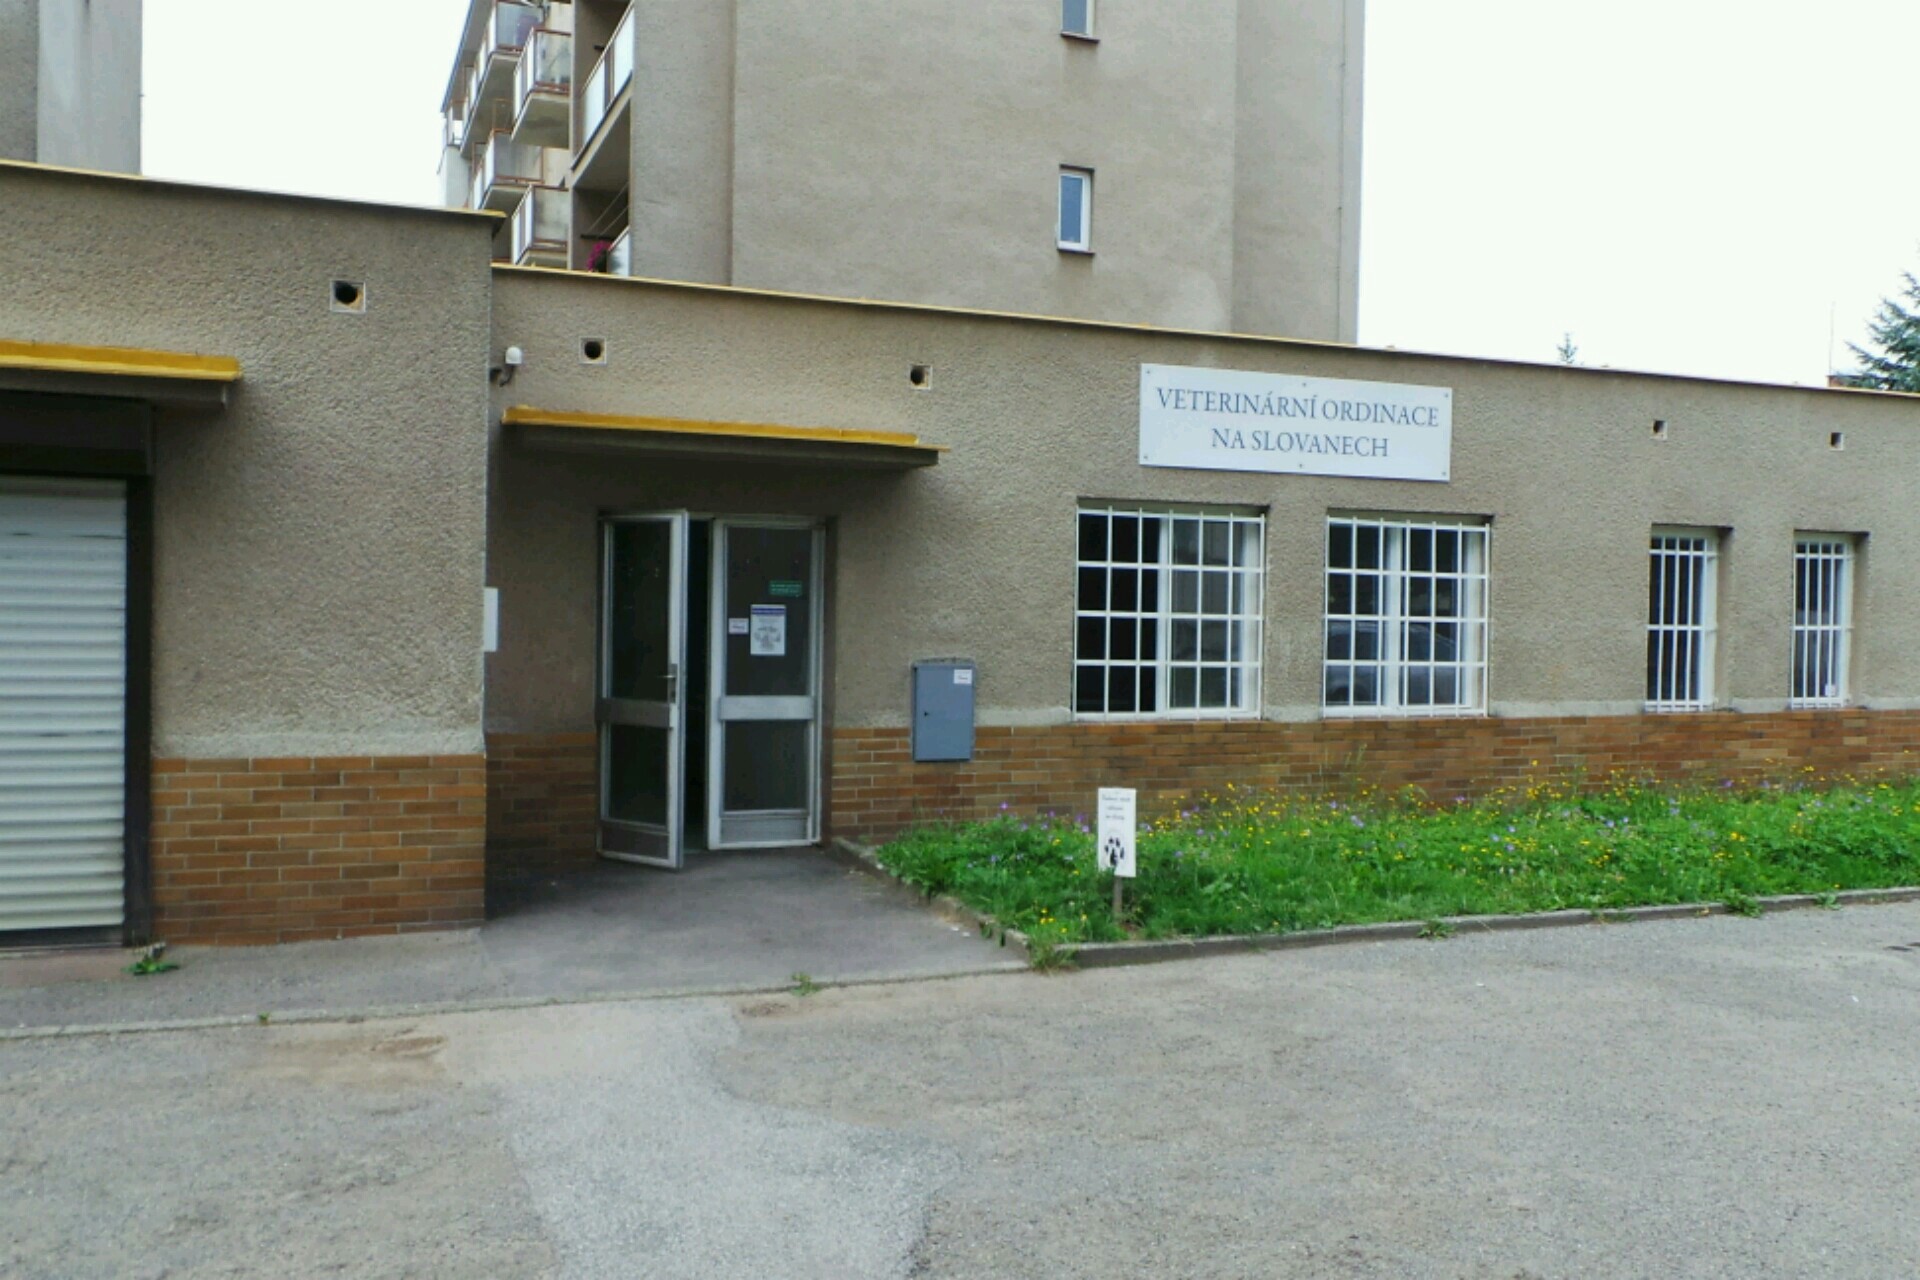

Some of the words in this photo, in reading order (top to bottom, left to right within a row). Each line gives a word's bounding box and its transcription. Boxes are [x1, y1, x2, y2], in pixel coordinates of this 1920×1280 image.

[1157, 387, 1317, 419] VETERINÁRNÍ
[1322, 399, 1439, 427] ORDINACE
[1212, 428, 1245, 449] NA
[1252, 430, 1389, 457] SLOVANECH
